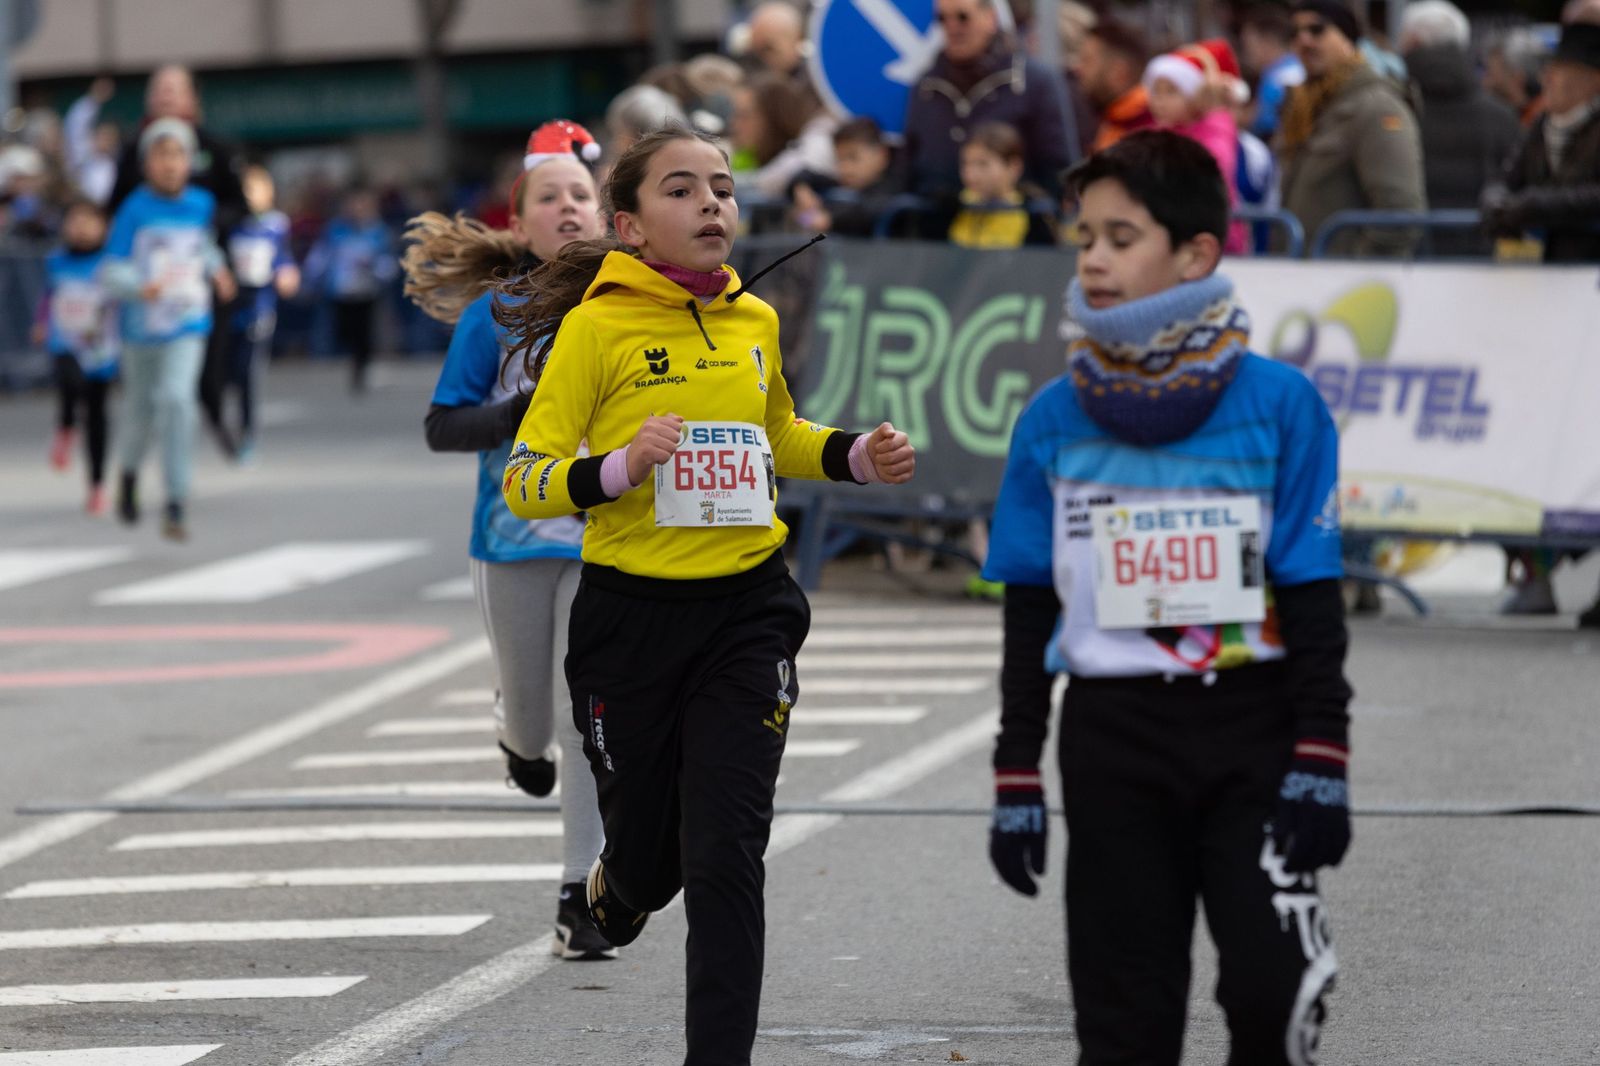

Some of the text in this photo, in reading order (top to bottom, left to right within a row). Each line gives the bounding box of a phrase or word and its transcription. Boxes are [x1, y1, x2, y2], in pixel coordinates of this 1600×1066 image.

[634, 375, 687, 388] BRAGANÇA
[1312, 365, 1489, 416] SETEL
[692, 428, 762, 447] SETEL
[674, 450, 756, 490] 6354
[704, 491, 732, 499] MARTA
[1133, 507, 1241, 531] SETEL
[1113, 534, 1218, 586] 6490
